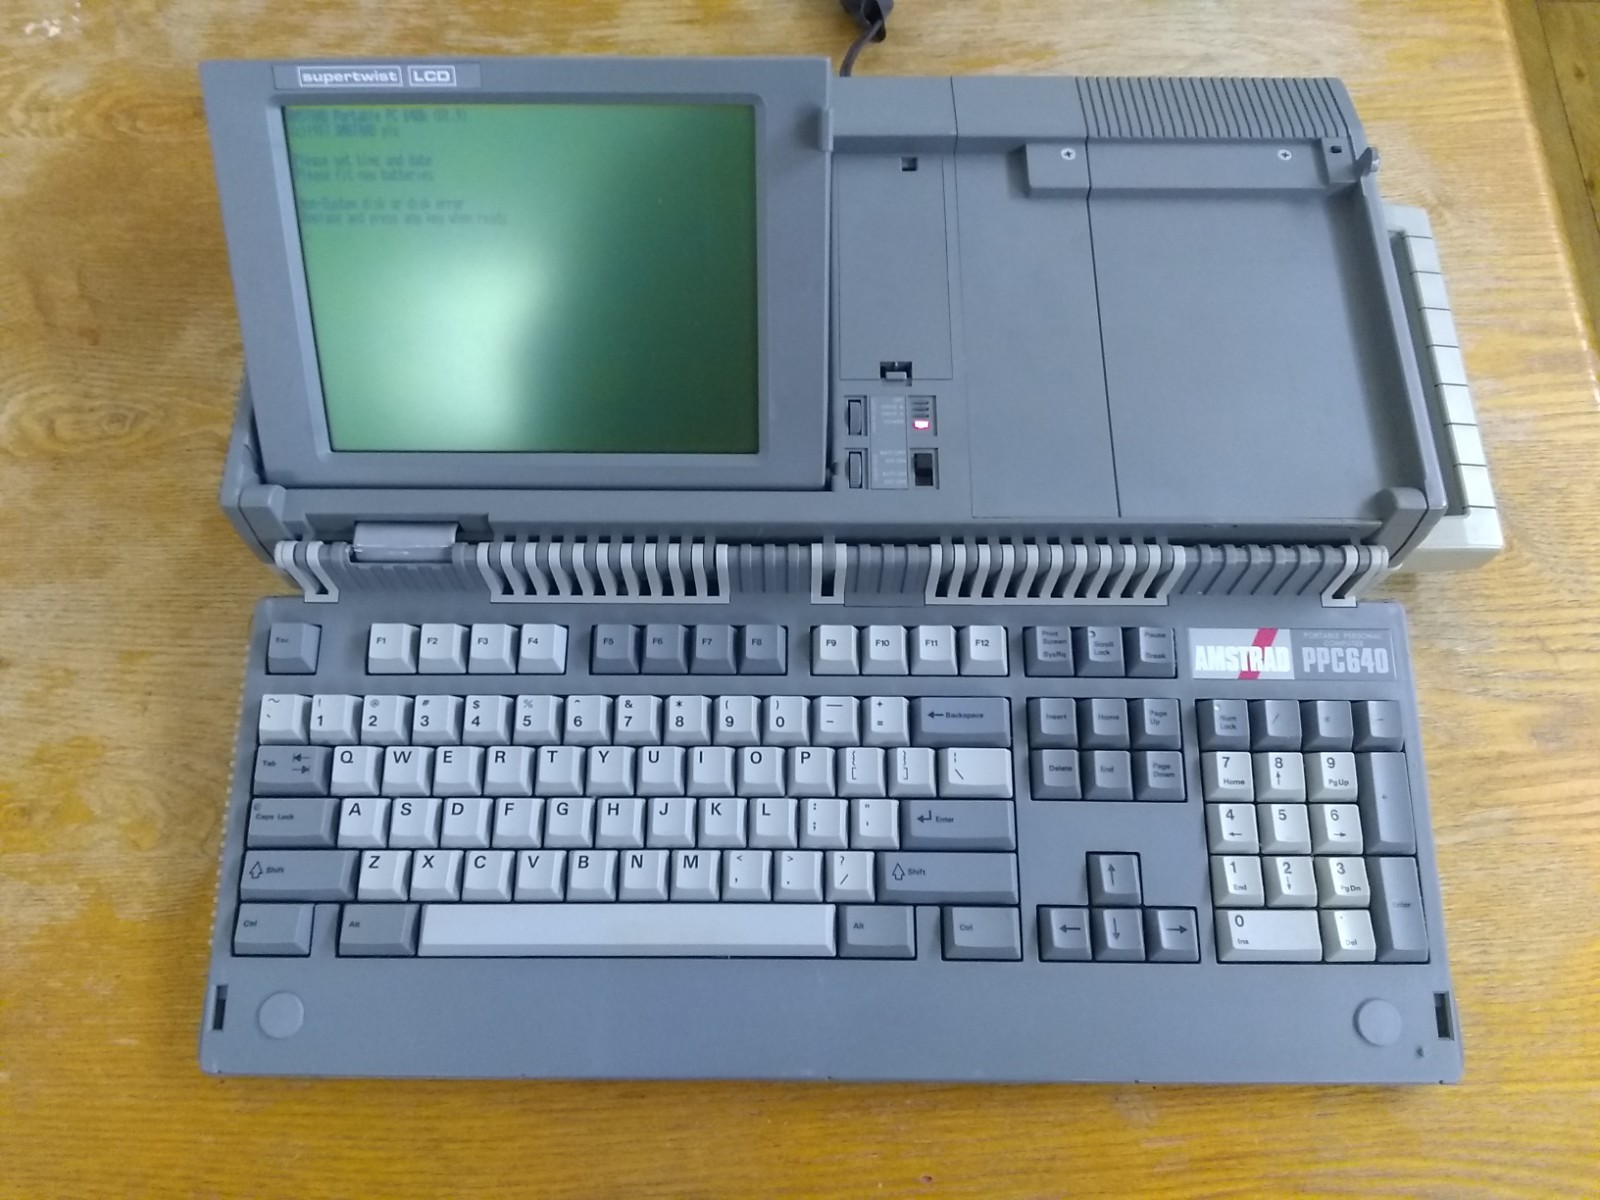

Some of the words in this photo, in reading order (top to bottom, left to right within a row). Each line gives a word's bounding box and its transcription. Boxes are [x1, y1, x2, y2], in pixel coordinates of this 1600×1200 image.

[302, 70, 398, 85] supertwist
[413, 70, 451, 82] LCD
[1195, 646, 1290, 672] AMSTRAD
[1302, 647, 1389, 673] PPC640
[318, 715, 323, 726] 1
[369, 715, 377, 726] 2
[420, 715, 429, 726] 3
[472, 716, 480, 726] 4
[523, 715, 531, 726] 5
[574, 716, 582, 727] 6
[625, 716, 632, 727] 7
[675, 716, 684, 727] 8
[725, 716, 734, 727] 9
[776, 716, 785, 727] 0
[341, 751, 353, 763] Q
[393, 751, 412, 763] W
[443, 751, 452, 763] E
[495, 751, 505, 763] R
[547, 751, 558, 763] T
[599, 751, 609, 763] Y
[649, 751, 659, 763] U
[750, 751, 762, 764] O
[801, 752, 810, 764] P
[1222, 757, 1230, 768] 7
[1275, 757, 1283, 768] 8
[1327, 757, 1335, 768] 9
[349, 803, 361, 815] A
[401, 803, 412, 815] S
[452, 803, 464, 815] D
[505, 803, 514, 815] F
[557, 802, 568, 815] G
[608, 803, 619, 815] H
[659, 803, 668, 815] J
[711, 803, 721, 815] K
[762, 803, 770, 816] L
[1226, 809, 1235, 820] 4
[1279, 809, 1287, 820] 5
[1331, 809, 1339, 821] 6
[369, 856, 380, 868] Z
[422, 855, 434, 868] X
[474, 856, 486, 868] C
[528, 856, 539, 868] V
[578, 856, 589, 868] B
[631, 855, 643, 868] N
[684, 855, 698, 868] M
[1230, 861, 1236, 873] 1
[1283, 862, 1292, 874] 2
[1337, 862, 1346, 874] 3
[853, 922, 864, 930] Alt
[959, 923, 973, 931] Ctrl
[1235, 915, 1244, 927] 0
